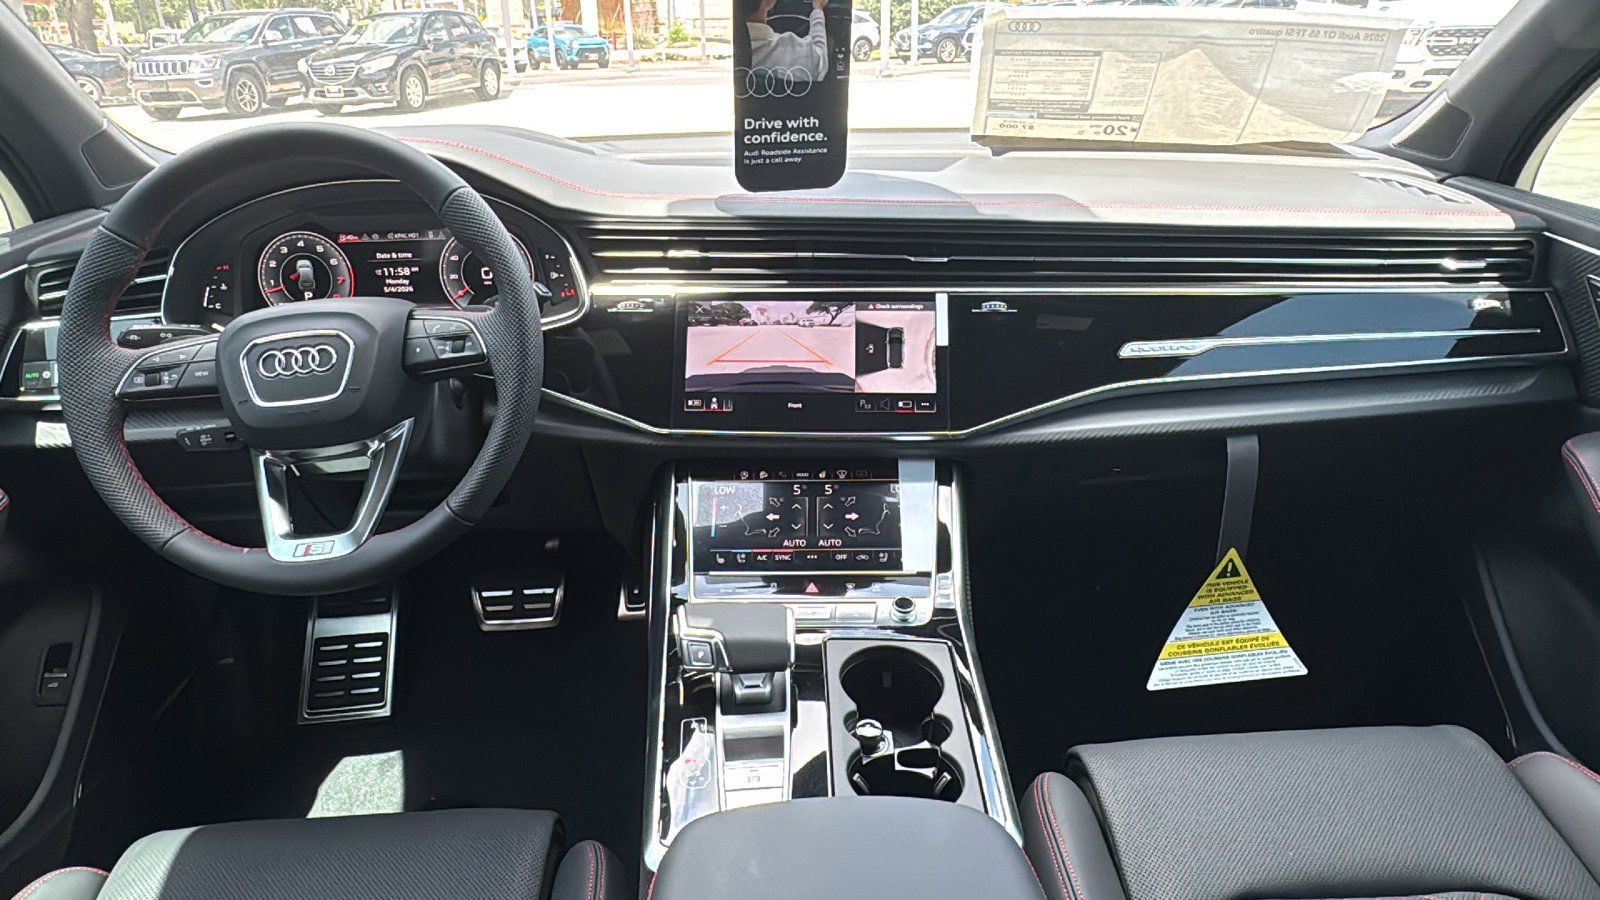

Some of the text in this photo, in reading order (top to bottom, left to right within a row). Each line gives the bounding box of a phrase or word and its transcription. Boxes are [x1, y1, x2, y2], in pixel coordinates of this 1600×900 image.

[744, 116, 819, 130] Drive with
[744, 131, 828, 144] confidence.
[761, 148, 792, 156] Roadside
[792, 147, 828, 155] Assistance
[750, 157, 765, 166] just
[280, 246, 288, 254] 3
[383, 267, 411, 276] 11:58
[304, 292, 313, 300] P
[714, 486, 736, 495] LOW
[793, 485, 833, 495] 5 5
[783, 539, 842, 547] AUTO AUTO
[756, 554, 768, 562] A/C
[774, 554, 792, 562] SYNC
[1214, 585, 1248, 593] EQUIPPED
[1217, 589, 1254, 598] ADVANCED
[1187, 640, 1220, 649] VÉHICULE
[1235, 635, 1260, 644] ÉQUIPÉ
[1167, 640, 1280, 658] COUSSINS GONFLABLES ÉVOLUÉS
[698, 651, 704, 659] P
